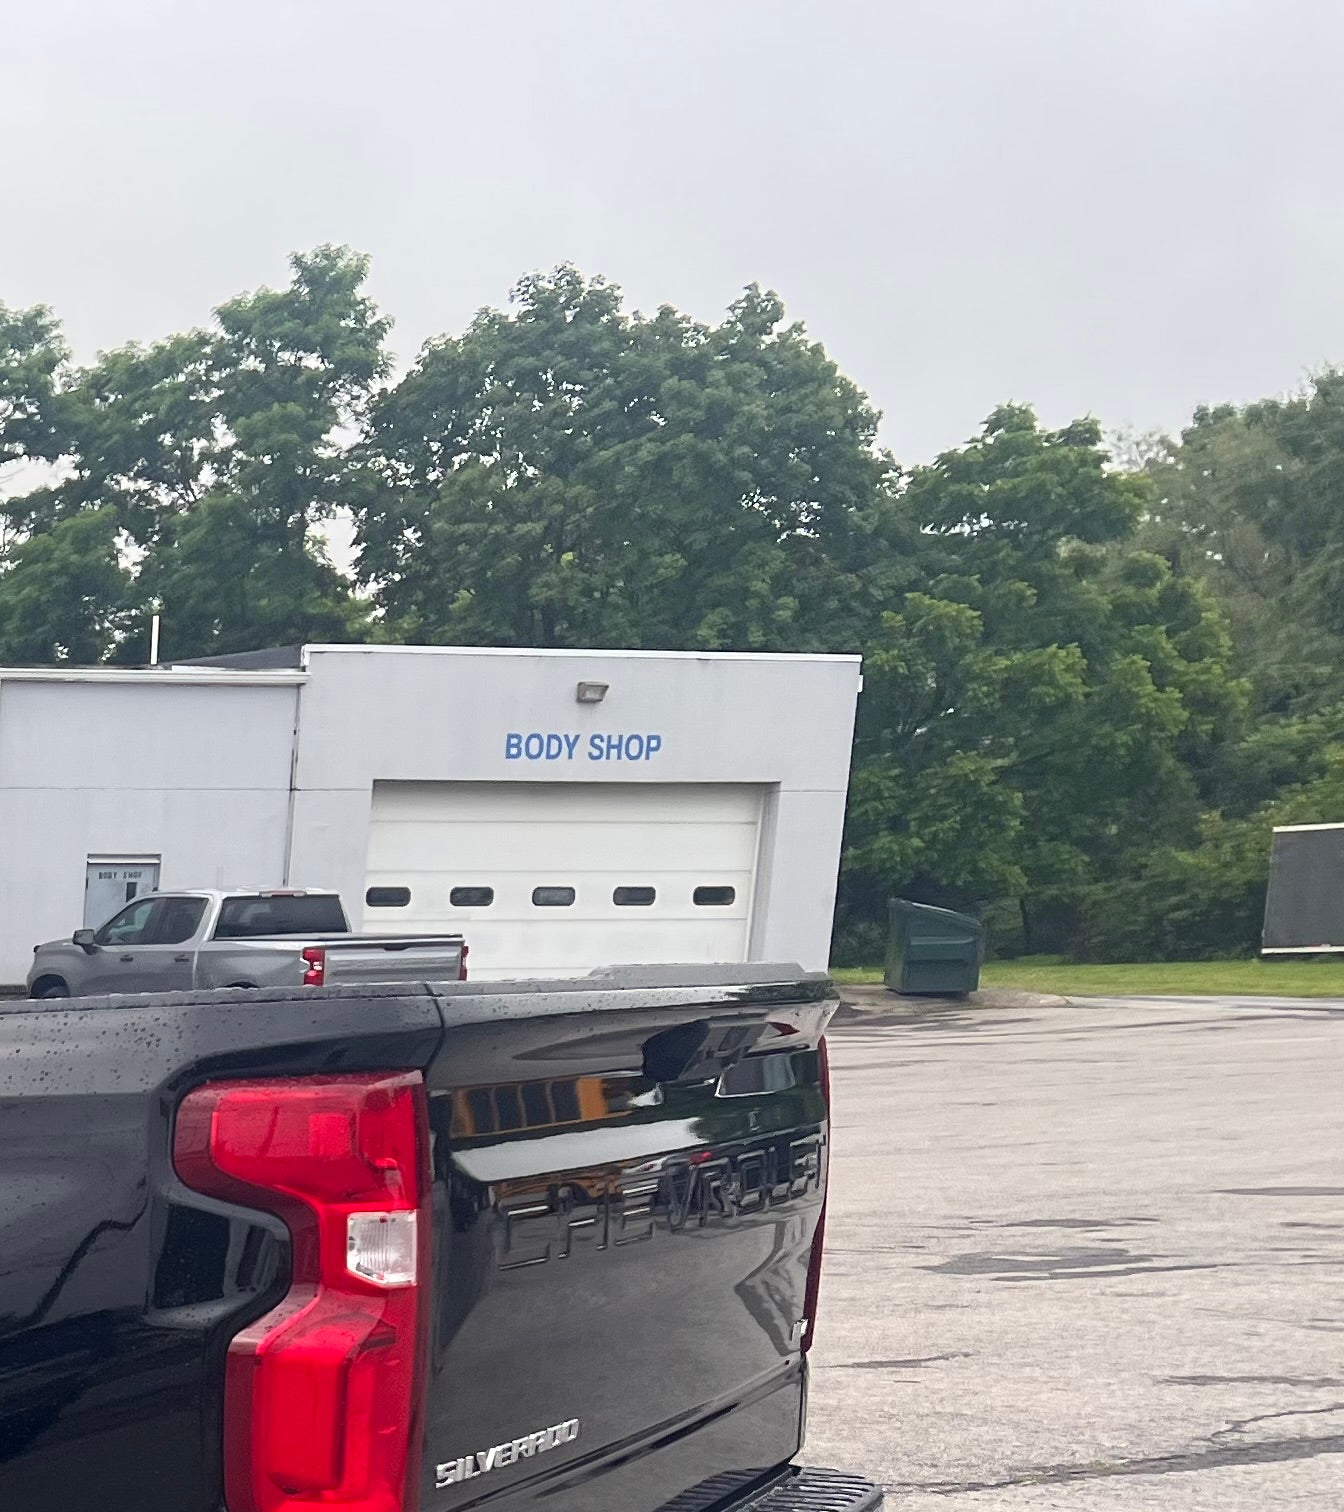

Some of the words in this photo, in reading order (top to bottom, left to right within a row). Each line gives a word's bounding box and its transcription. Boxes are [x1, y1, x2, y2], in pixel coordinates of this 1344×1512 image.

[505, 733, 581, 760] BODY
[587, 734, 662, 761] SHOP
[98, 871, 118, 880] BODY
[123, 871, 143, 880] SHOP
[497, 1133, 826, 1271] CHEVROLET
[435, 1418, 579, 1489] SILVERADO
